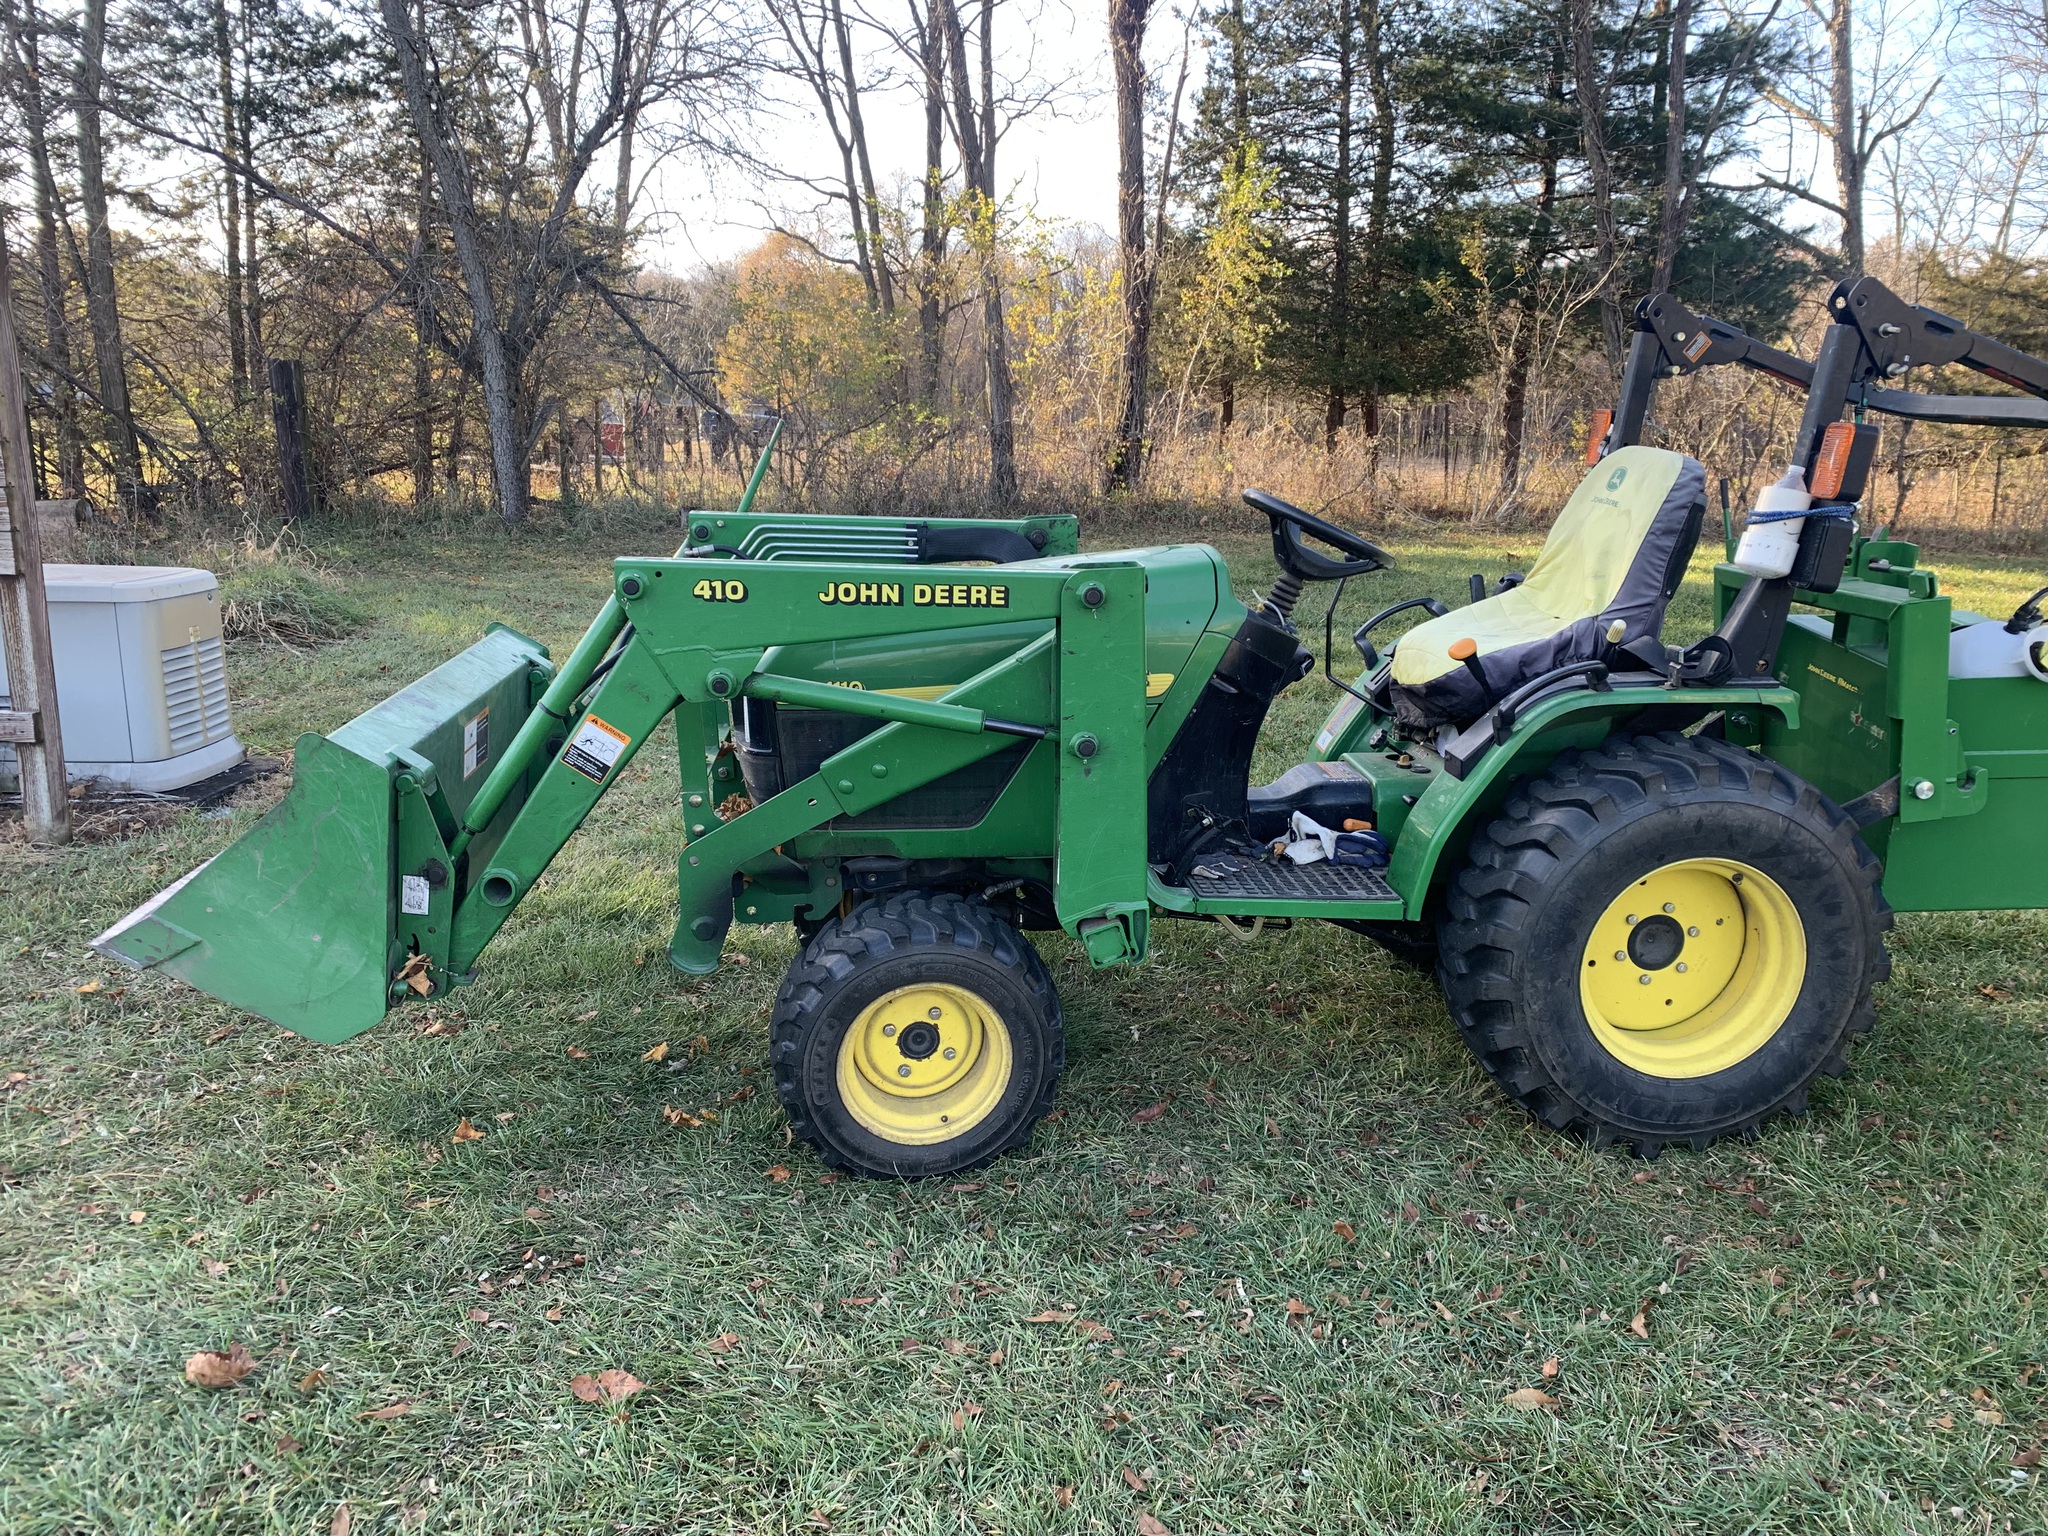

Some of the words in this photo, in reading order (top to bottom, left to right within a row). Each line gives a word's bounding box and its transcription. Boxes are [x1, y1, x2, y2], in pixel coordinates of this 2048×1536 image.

[692, 579, 748, 603] 410
[818, 582, 903, 606] JOHN
[913, 584, 1008, 608] DEERE
[600, 721, 627, 741] WARNING
